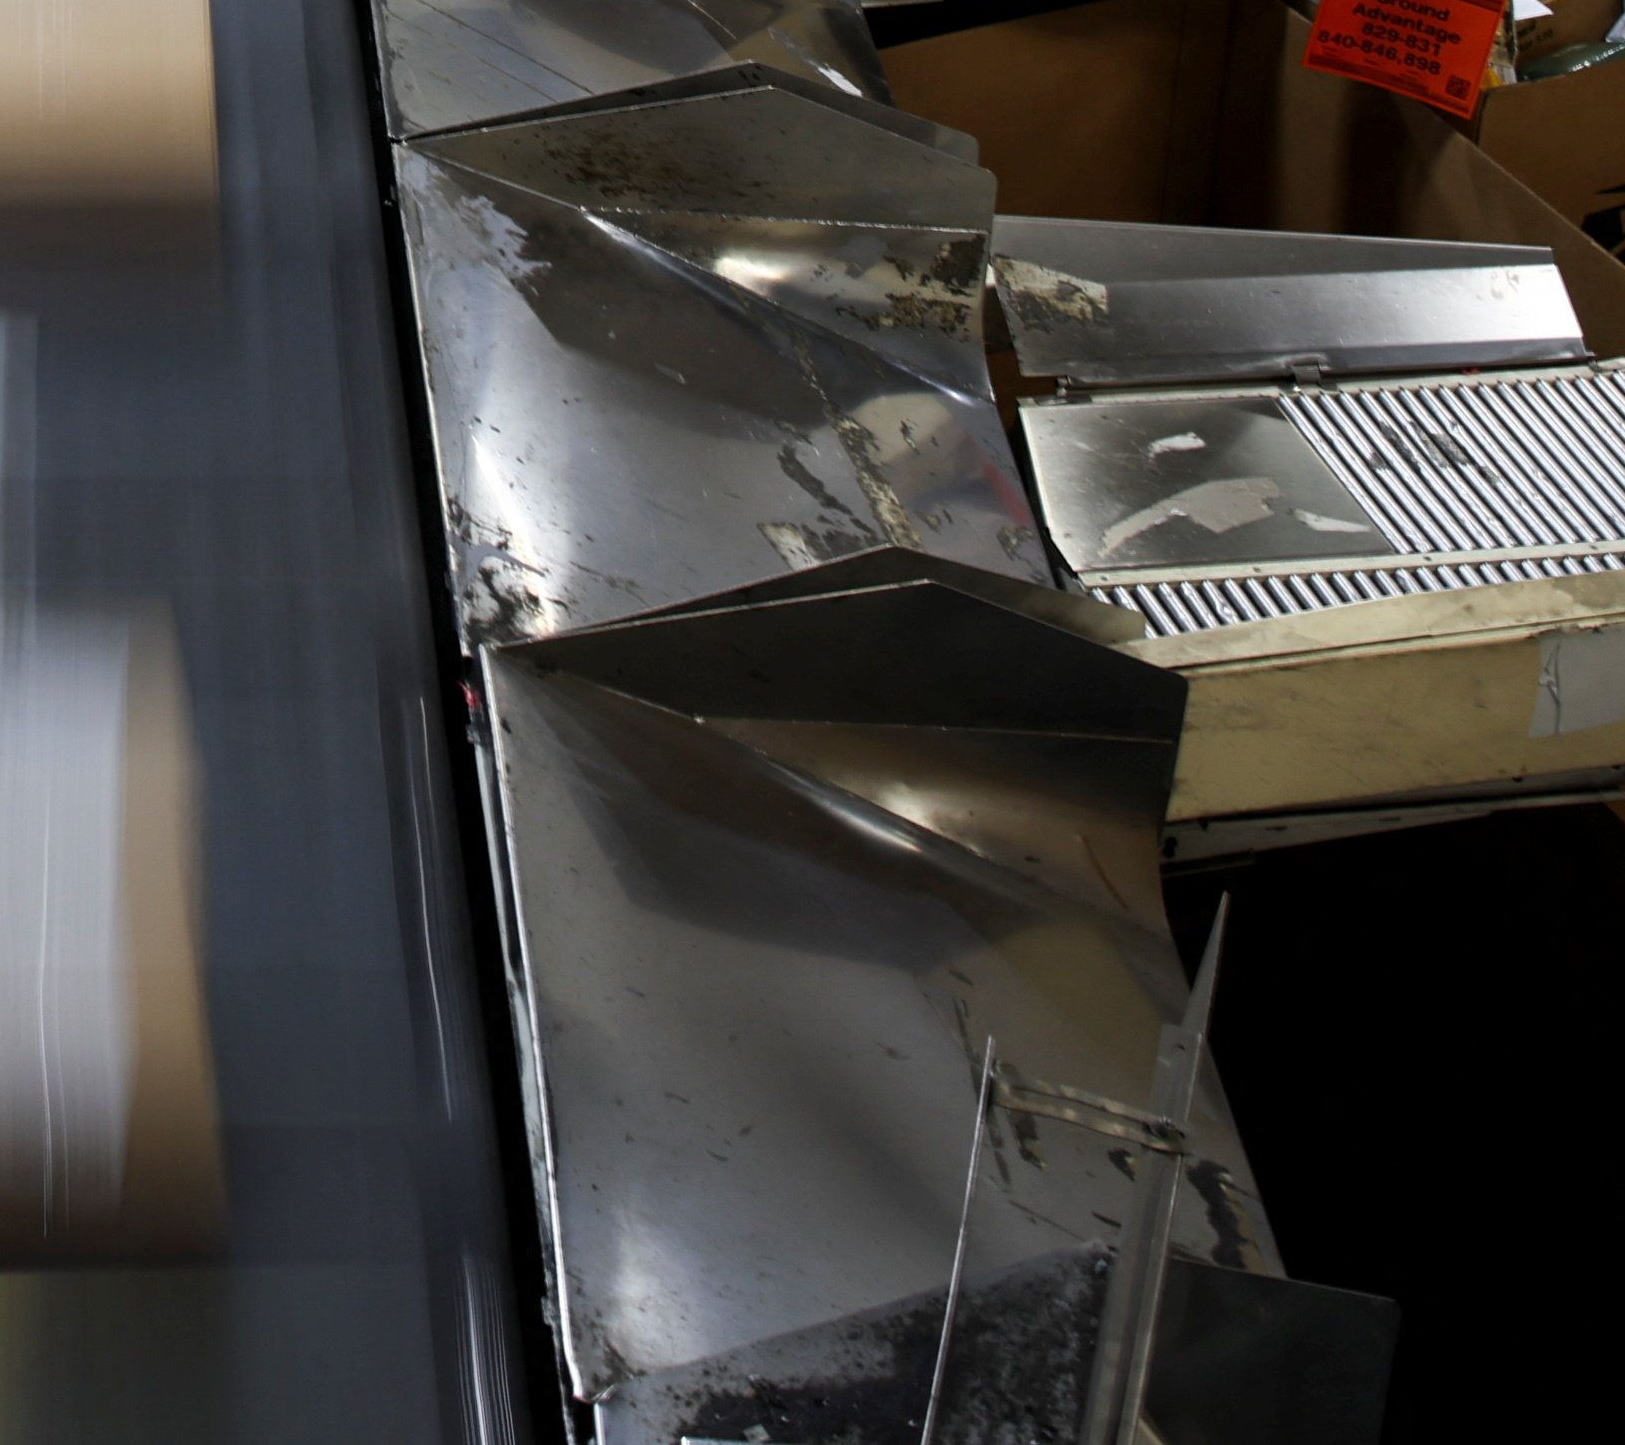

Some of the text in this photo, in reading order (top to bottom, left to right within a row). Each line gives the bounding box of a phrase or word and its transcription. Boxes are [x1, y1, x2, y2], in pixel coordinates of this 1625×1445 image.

[1352, 2, 1462, 45] Advantage
[1362, 21, 1441, 57] 829-831
[1316, 29, 1442, 75] 840-846,898
